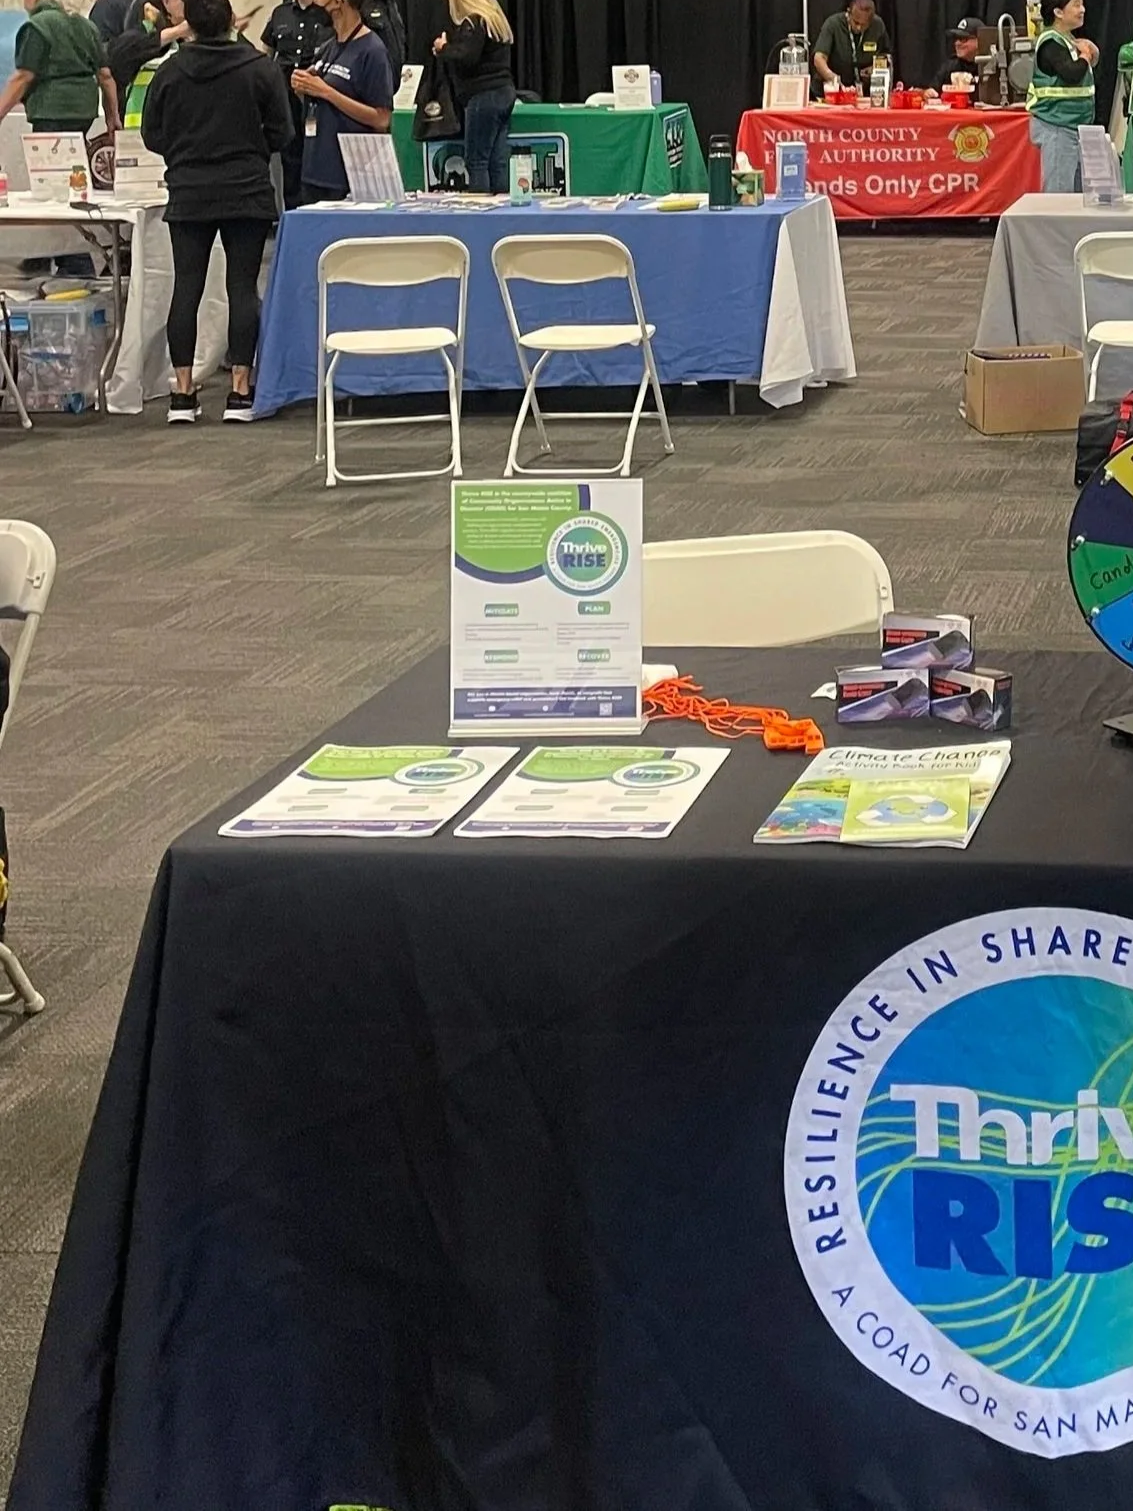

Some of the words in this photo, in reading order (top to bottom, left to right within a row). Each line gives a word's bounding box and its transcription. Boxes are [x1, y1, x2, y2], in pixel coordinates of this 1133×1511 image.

[763, 128, 833, 144] NORTH
[839, 127, 922, 144] COUNTY
[820, 147, 940, 164] AUTHORITY
[865, 174, 921, 198] Only
[929, 173, 979, 194] CPR
[561, 542, 607, 554] Thrive
[562, 553, 606, 568] RISE
[829, 750, 913, 763] Climate
[805, 994, 898, 1254] RESILIENCE
[906, 949, 958, 993] IN
[832, 1285, 855, 1308] A
[856, 1311, 931, 1377] COAD
[942, 1372, 998, 1420] FOR
[1014, 1412, 1078, 1439] SAN
